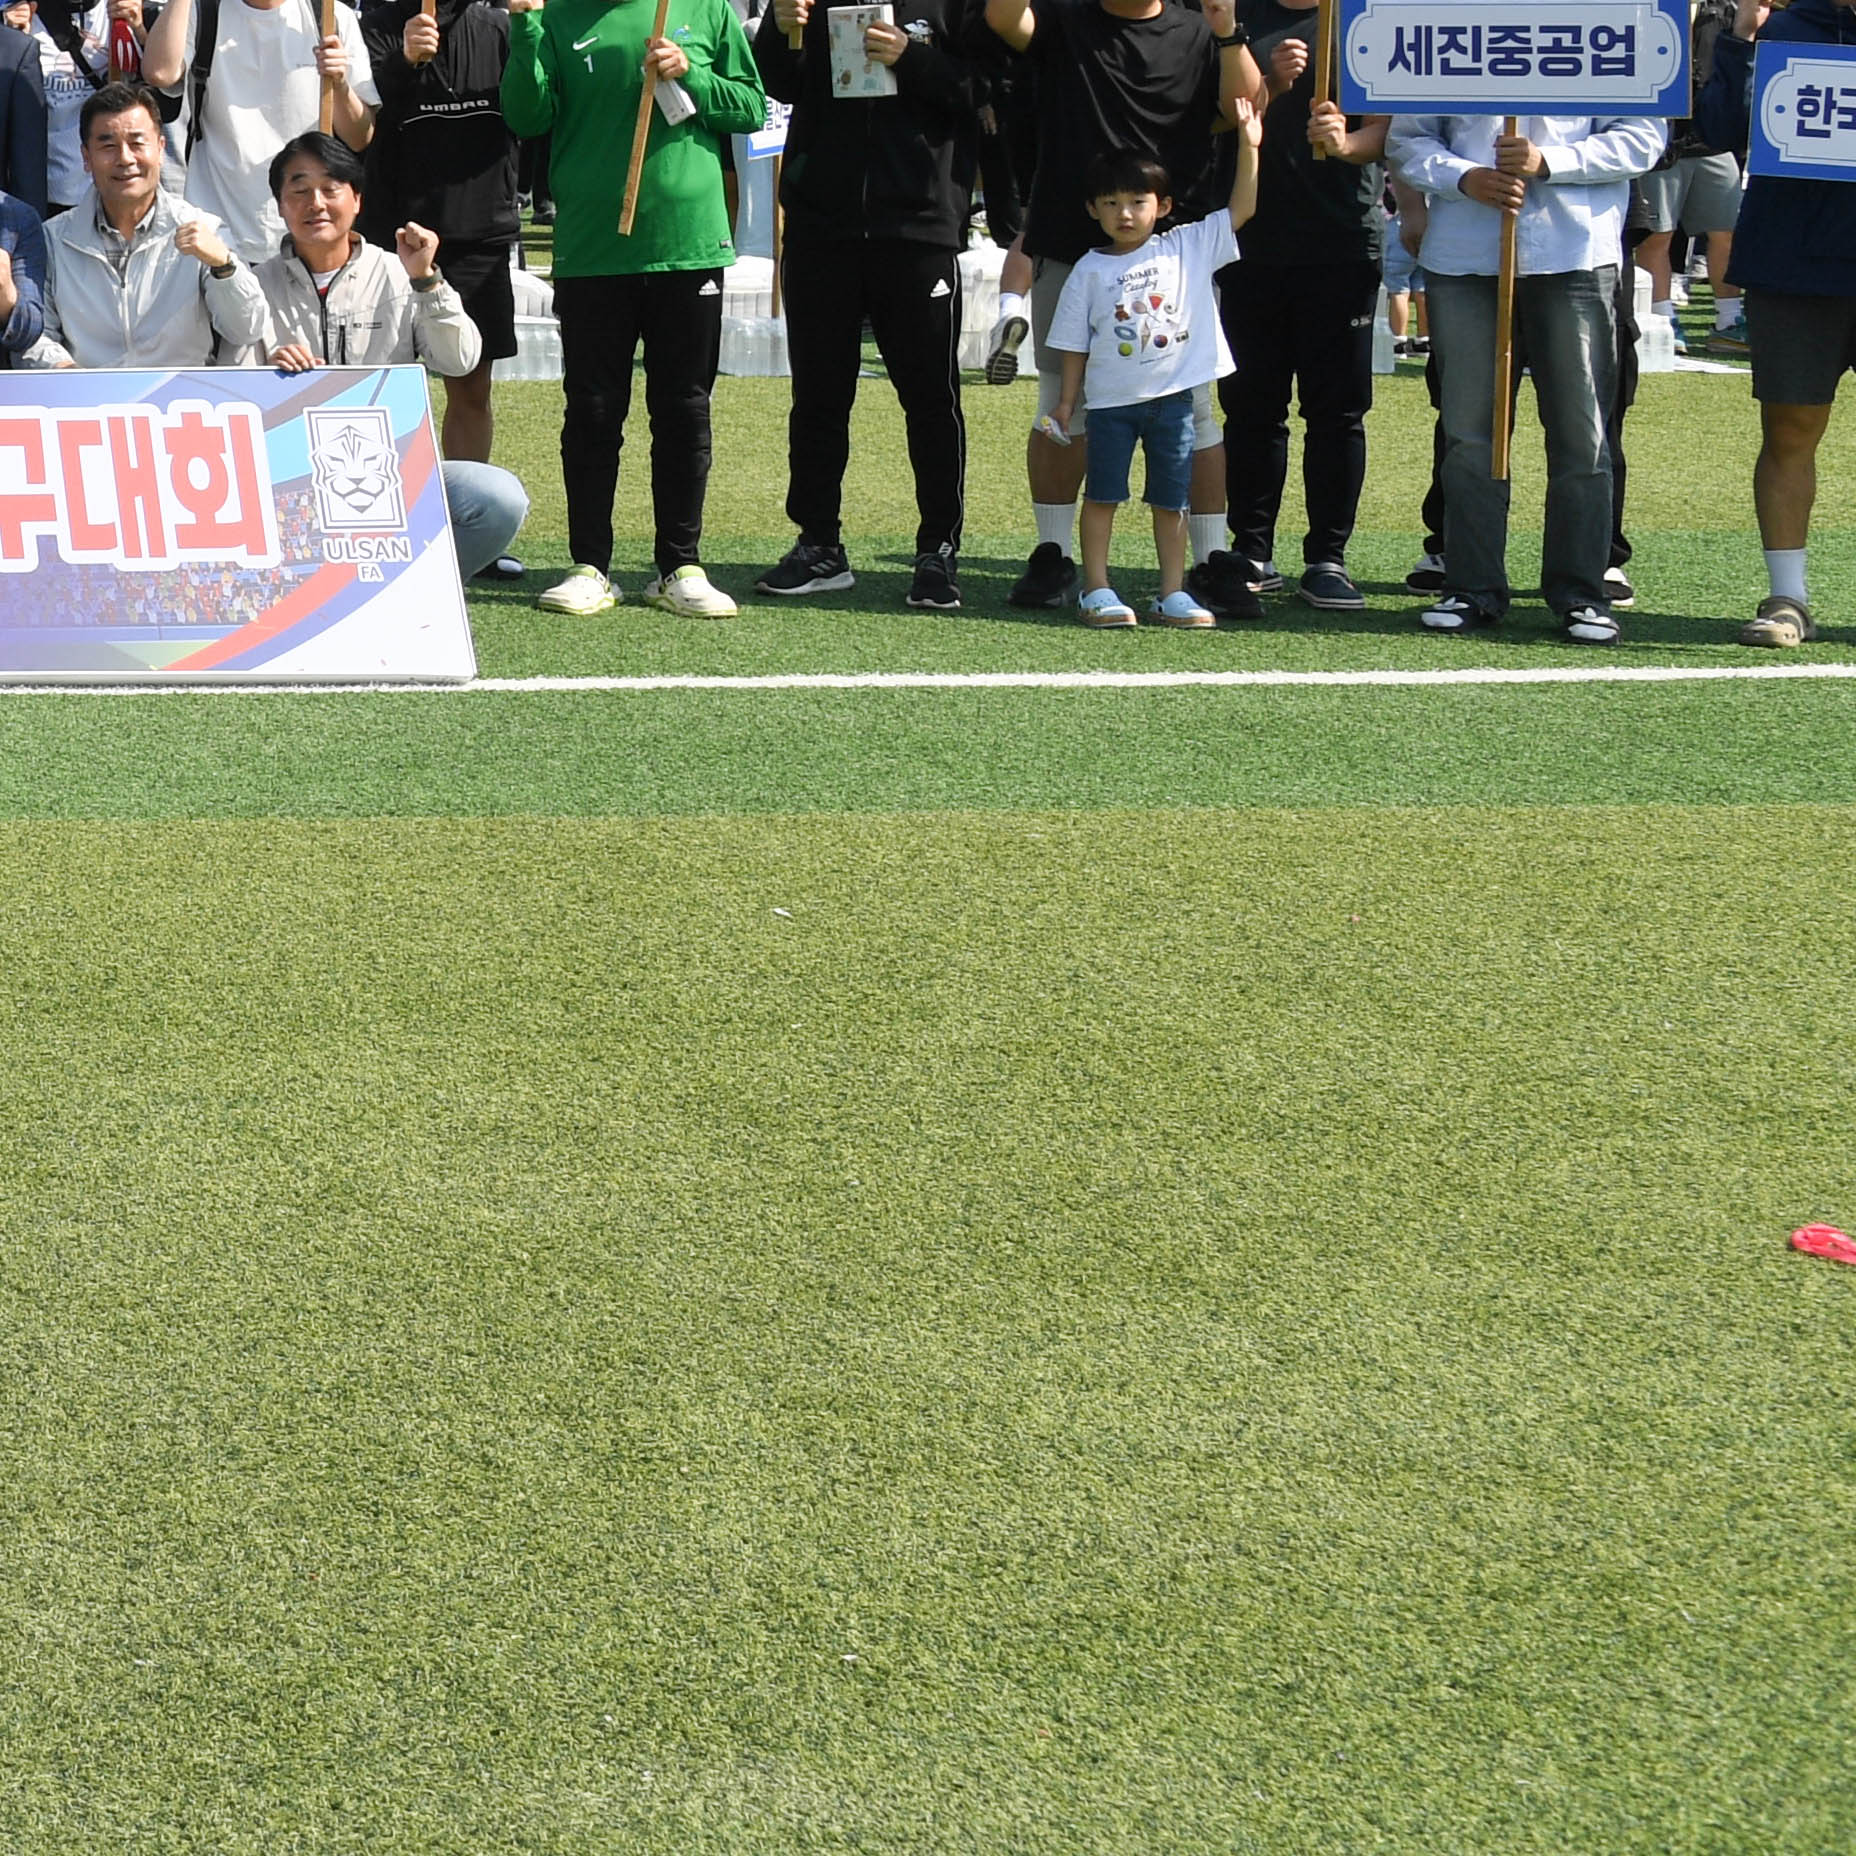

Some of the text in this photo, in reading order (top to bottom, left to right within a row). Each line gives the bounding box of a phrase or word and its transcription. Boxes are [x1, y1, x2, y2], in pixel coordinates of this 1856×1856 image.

[1388, 25, 1635, 76] 세진중공업
[583, 53, 594, 73] 1
[324, 538, 411, 561] ULSAN
[359, 565, 382, 580] FA
